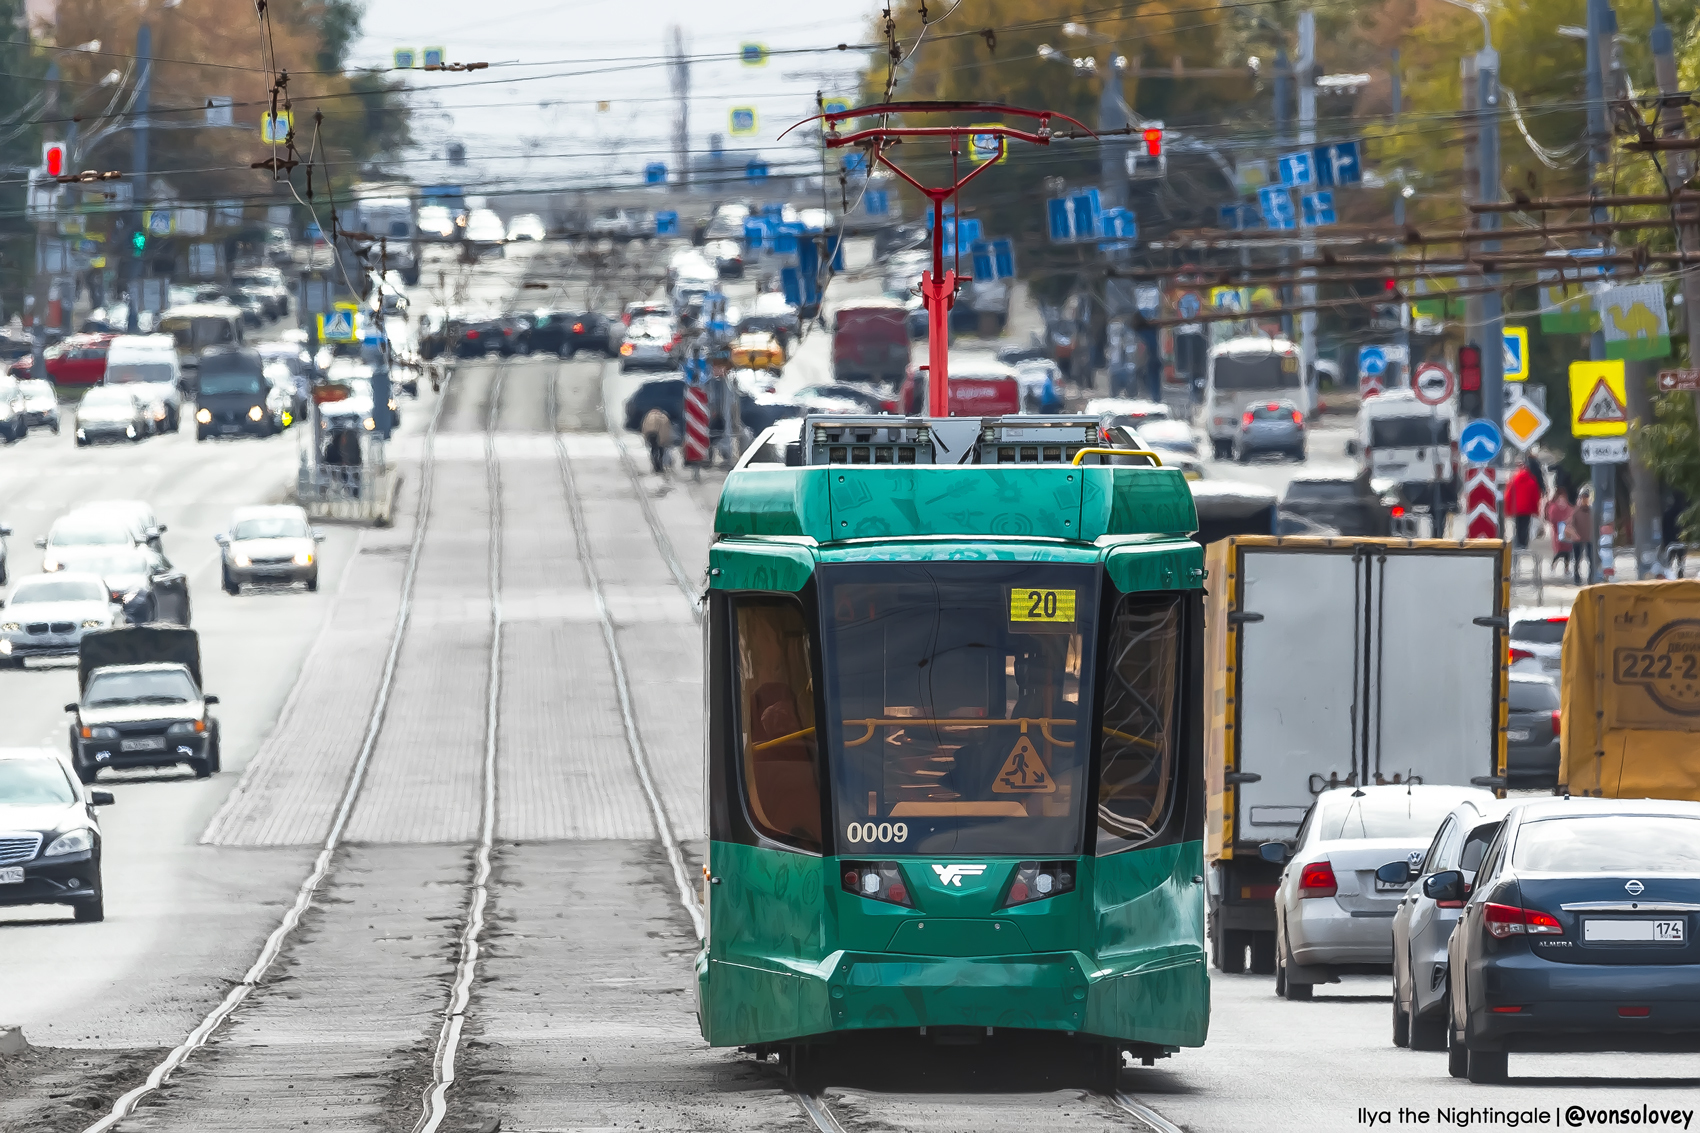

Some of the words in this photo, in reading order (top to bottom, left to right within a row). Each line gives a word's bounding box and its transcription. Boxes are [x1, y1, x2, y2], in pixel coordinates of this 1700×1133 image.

[1028, 591, 1057, 618] 20
[847, 822, 908, 843] 0009
[1656, 922, 1681, 935] 174
[1538, 940, 1573, 948] ALMERA
